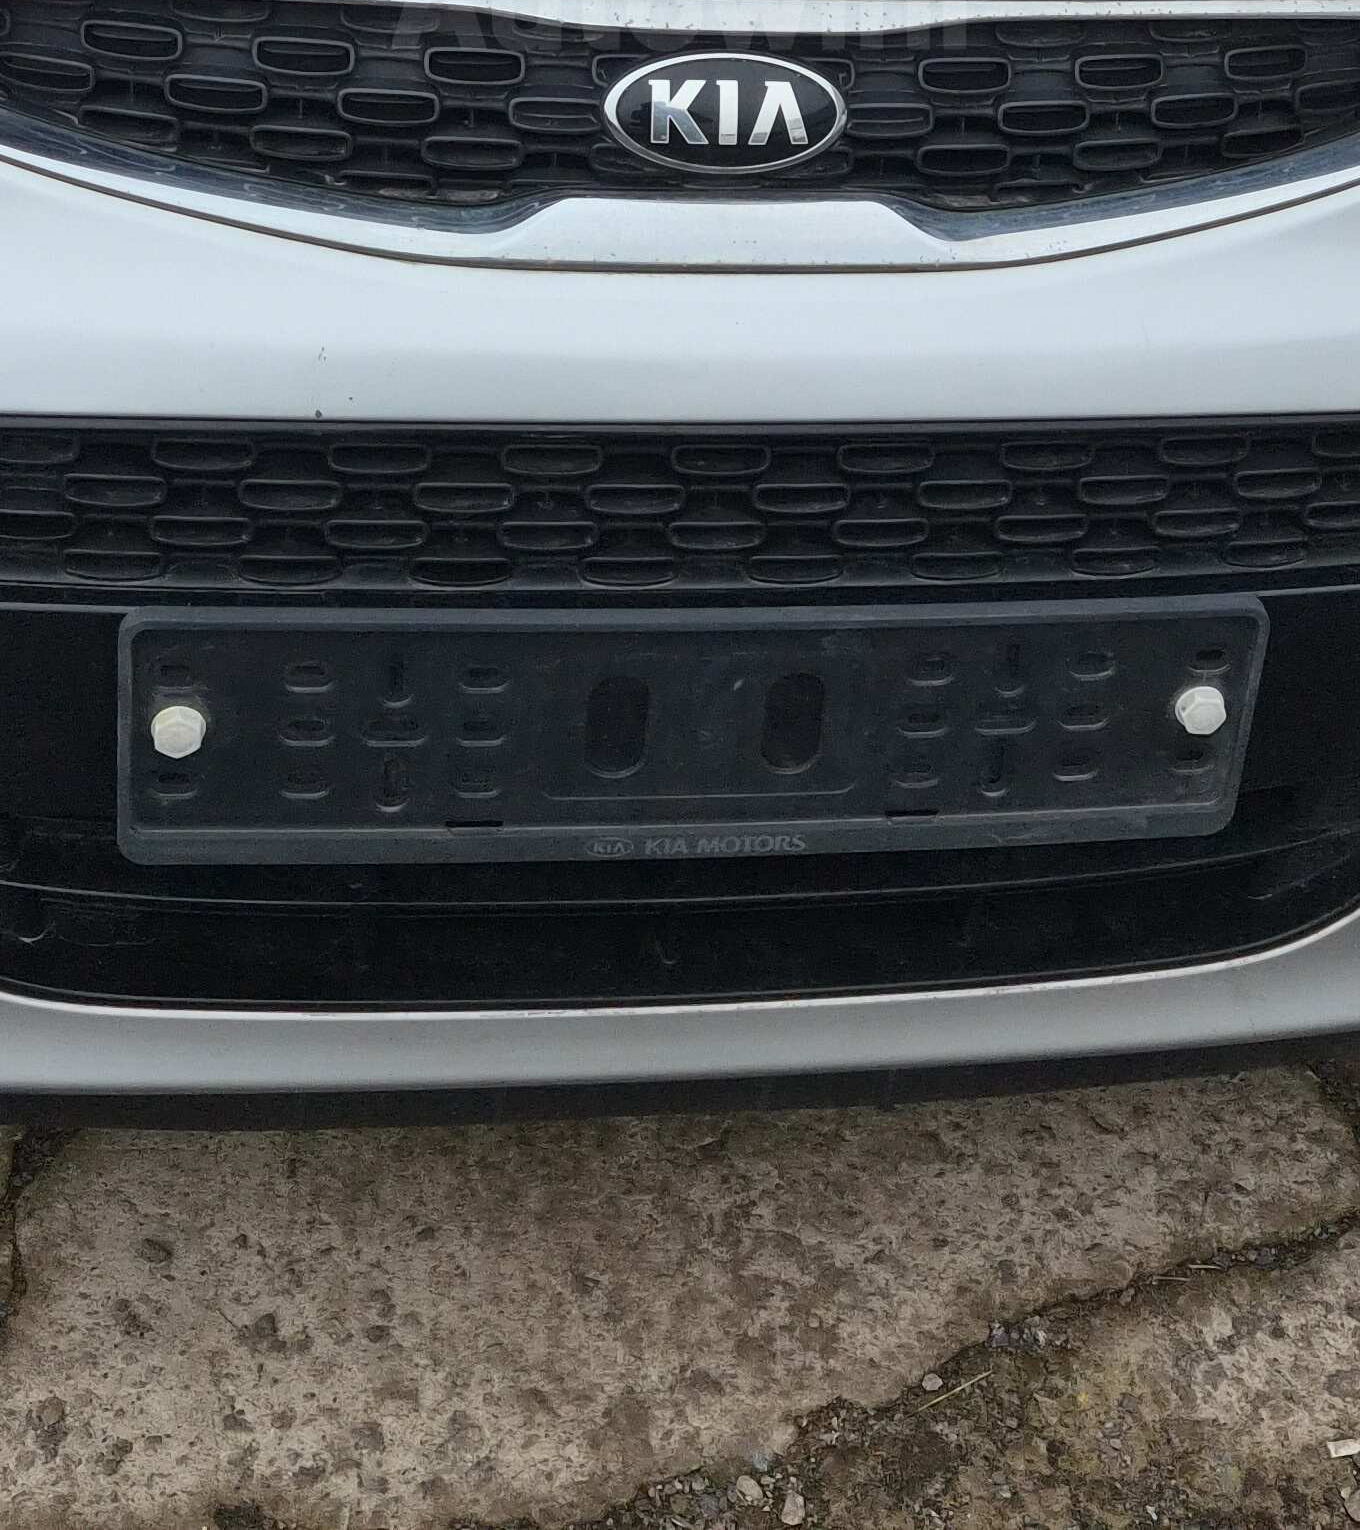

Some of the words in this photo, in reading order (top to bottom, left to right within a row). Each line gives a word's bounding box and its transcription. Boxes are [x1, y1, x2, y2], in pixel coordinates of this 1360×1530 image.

[648, 78, 809, 146] KIA
[645, 836, 689, 855] KIA
[697, 833, 806, 854] MOTORS
